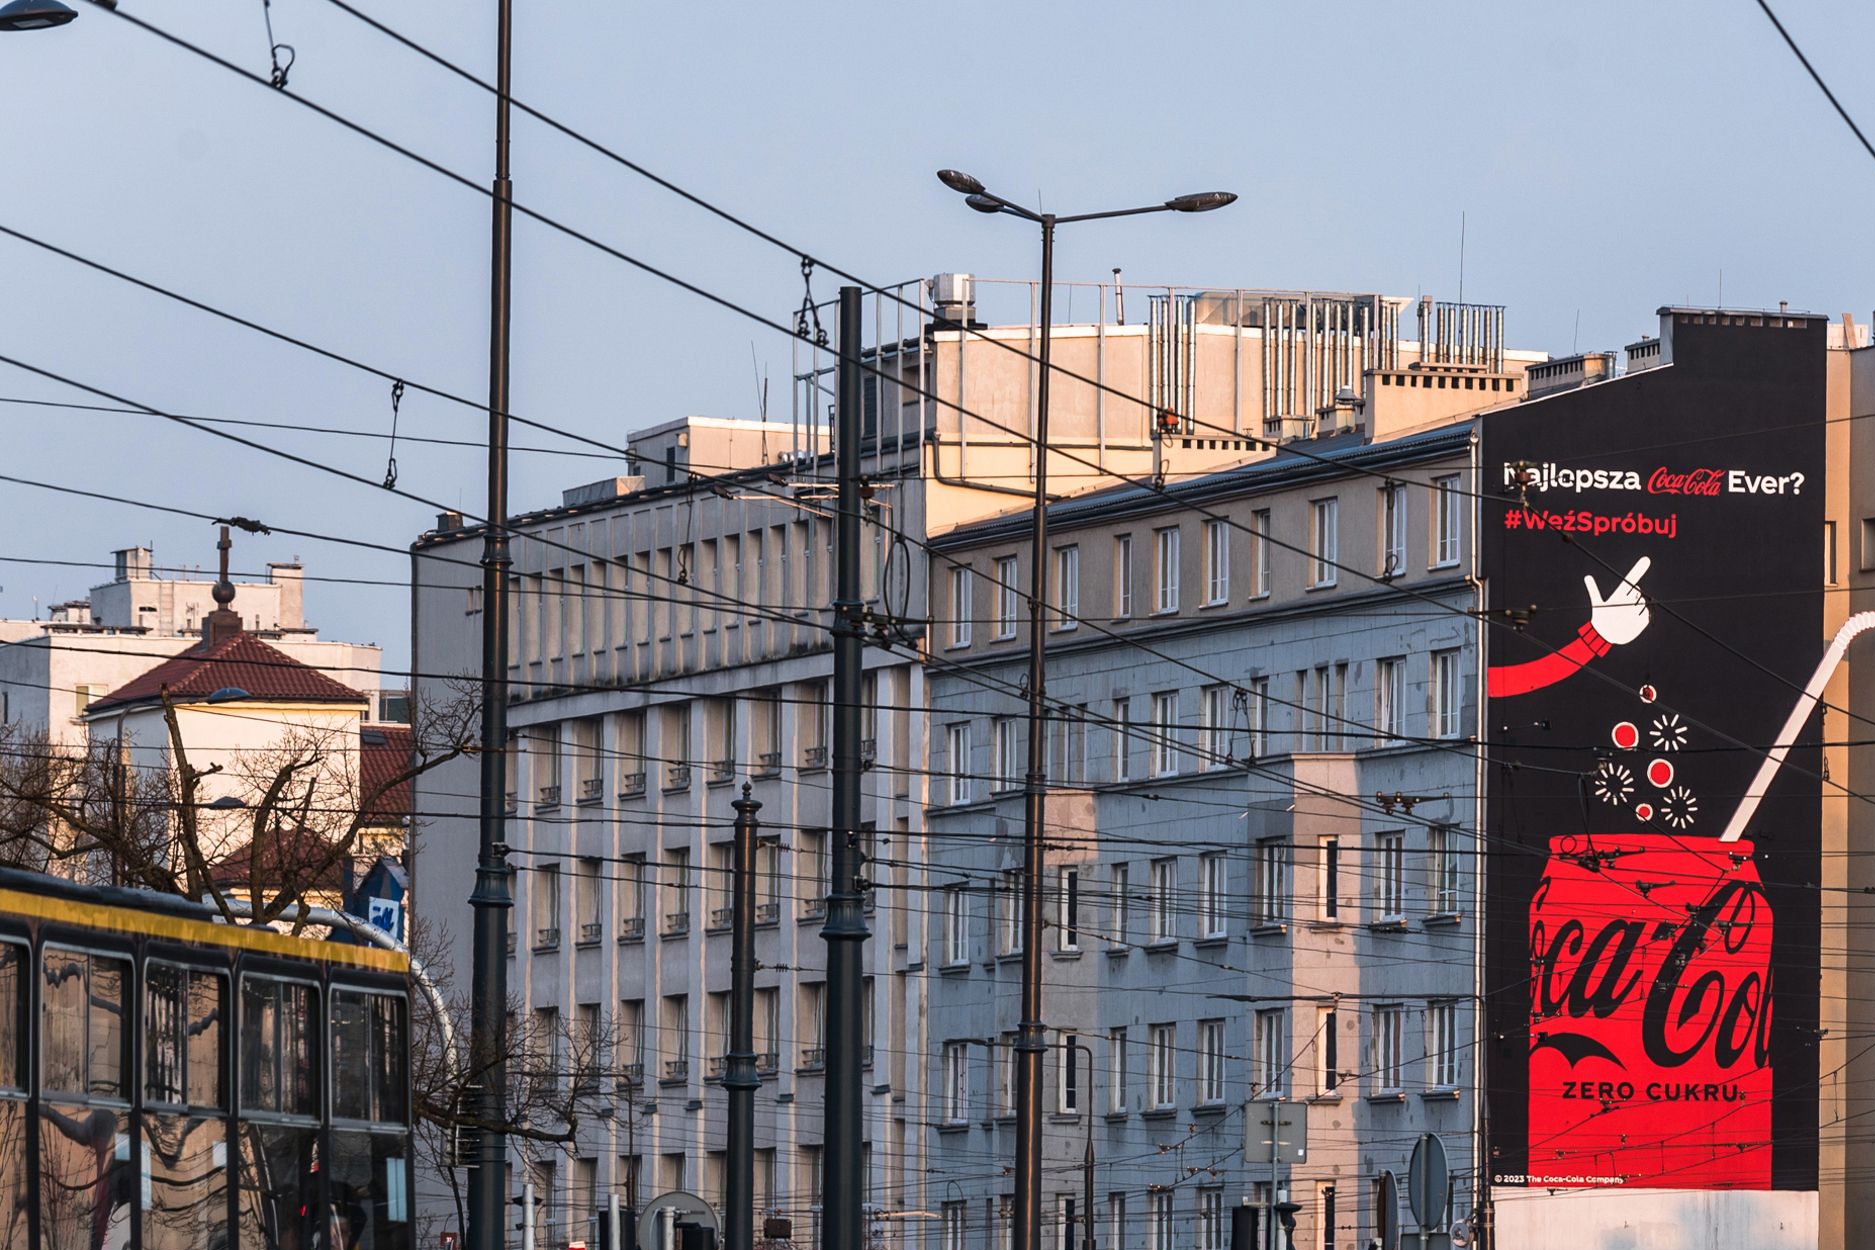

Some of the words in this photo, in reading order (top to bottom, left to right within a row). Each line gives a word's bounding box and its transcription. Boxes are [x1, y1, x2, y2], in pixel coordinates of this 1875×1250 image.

[1503, 462, 1642, 493] Najlepsza
[1647, 466, 1726, 497] Coca-Cola
[1728, 469, 1805, 495] Ever?
[1503, 509, 1677, 540] #WeźSpróbuj
[1562, 1081, 1635, 1100] ZERO
[1645, 1082, 1739, 1101] CUKRU
[1504, 1175, 1525, 1183] 2023
[1526, 1175, 1542, 1183] The
[1543, 1175, 1585, 1183] Coca-Cola
